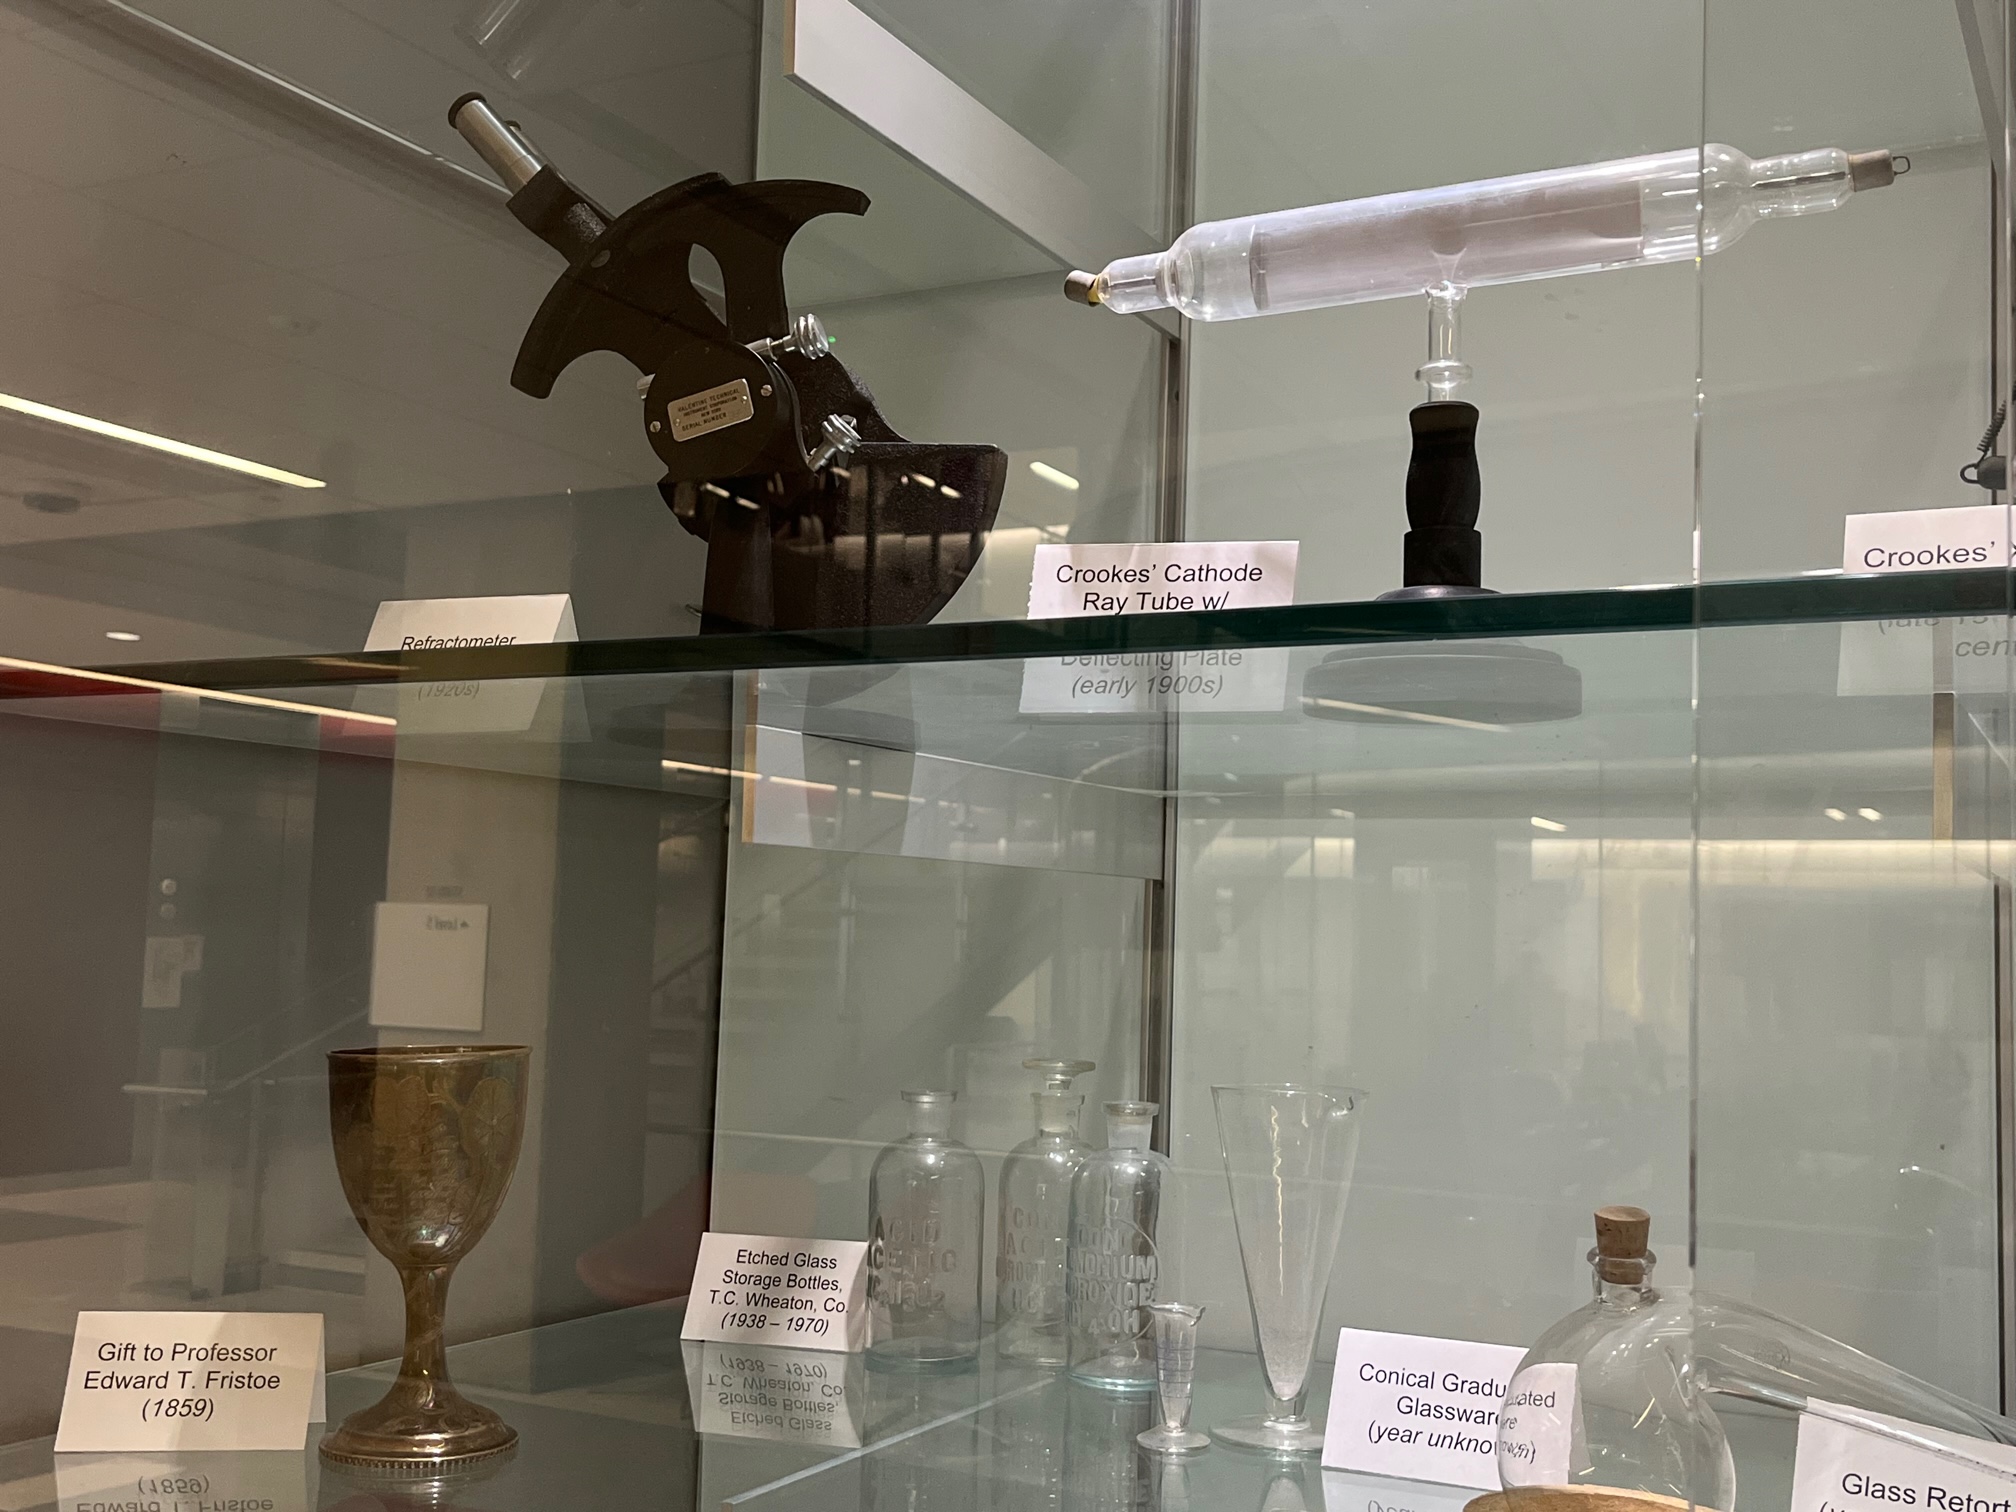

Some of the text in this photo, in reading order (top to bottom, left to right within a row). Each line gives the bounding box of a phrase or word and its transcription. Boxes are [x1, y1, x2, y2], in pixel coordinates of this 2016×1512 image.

[677, 388, 740, 412] VALENTINE TECHNICAL
[682, 412, 727, 432] SERIAL NUMBER
[1863, 541, 1996, 568] Crookes’
[1056, 563, 1263, 583] Crookes’ Cathode
[1082, 591, 1230, 615] Ray Tube w/
[401, 634, 517, 651] Refractometer
[1955, 638, 2016, 658] cen
[1061, 652, 1174, 671] Deflecting
[417, 681, 480, 701] (1920s)
[1072, 674, 1223, 699] (early 1900s)
[736, 1249, 838, 1270] Etched Glass
[722, 1270, 843, 1293] Storage Bottles,
[709, 1290, 849, 1314] T.C. Wheaton, Co.
[721, 1312, 768, 1330] (1938
[786, 1317, 830, 1337] 1970)
[98, 1342, 278, 1362] Gift to Professor
[84, 1370, 281, 1390] Edward T. Fristoe
[1359, 1362, 1436, 1390] Conical
[142, 1398, 215, 1422] (1859)
[1368, 1420, 1424, 1445] (year
[1842, 1472, 2012, 1512] Glass Retort
